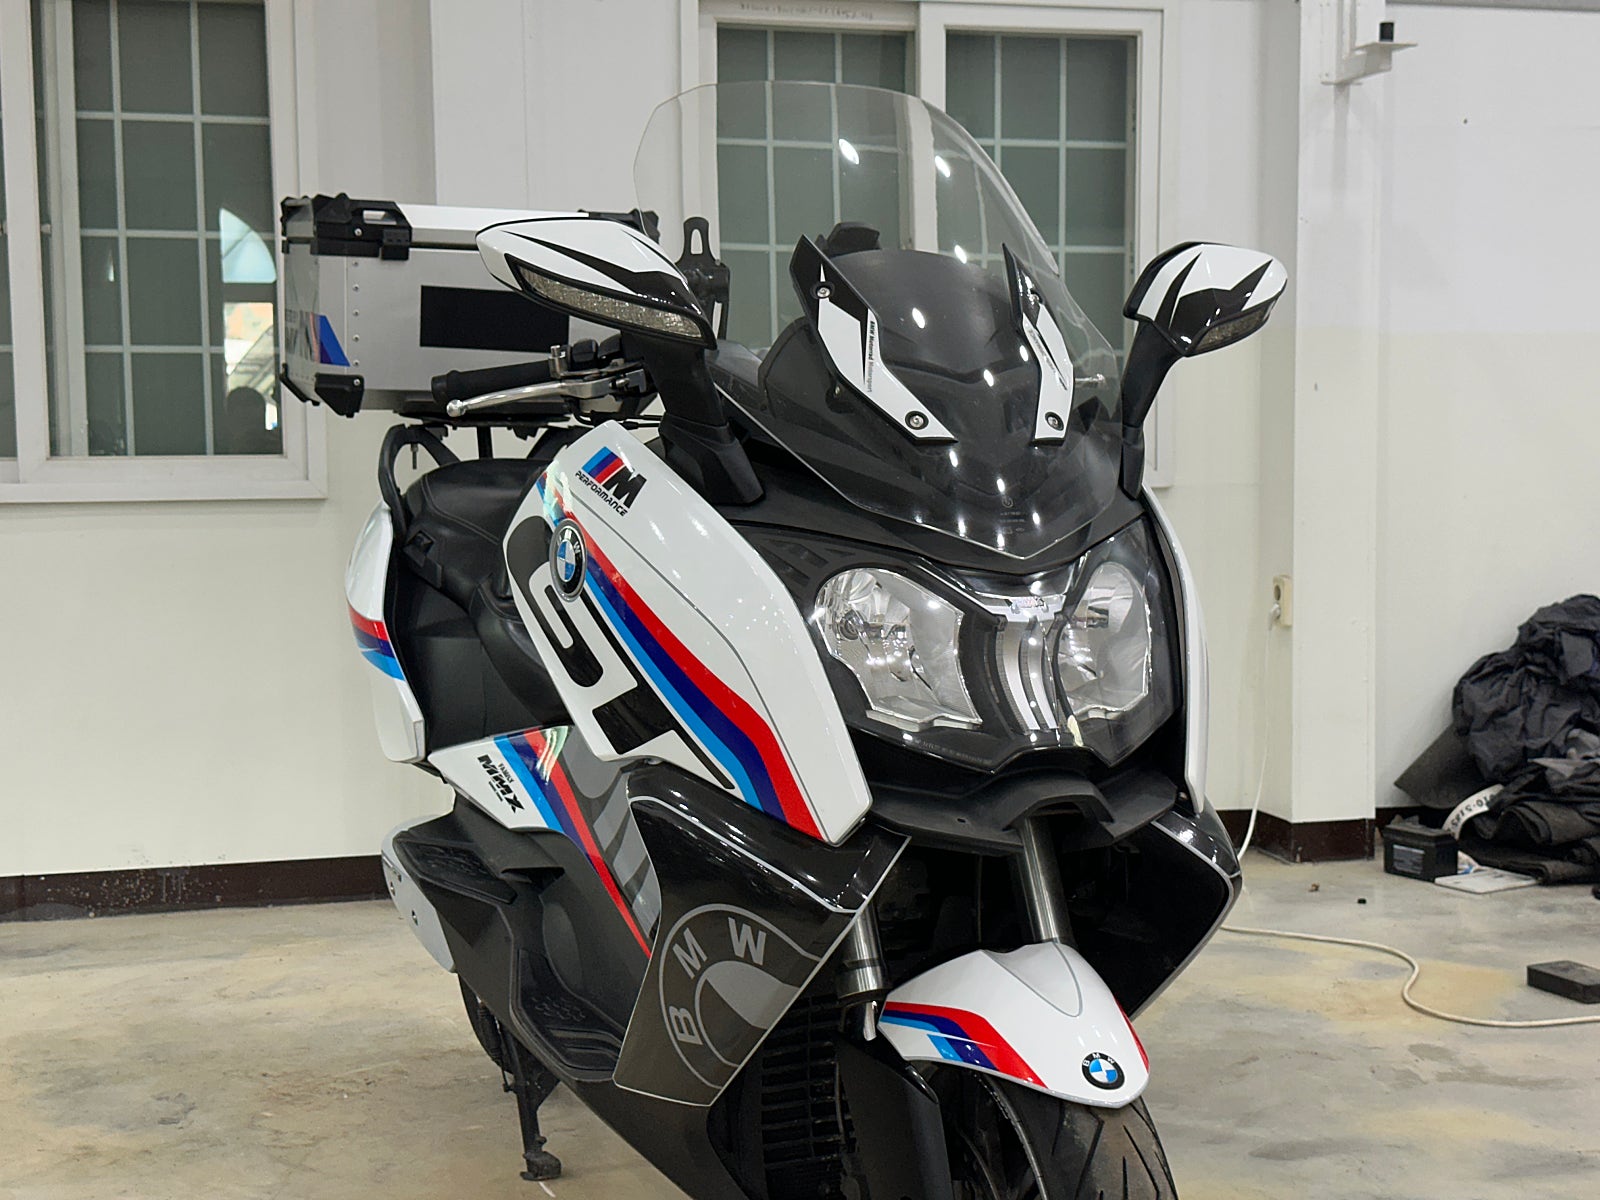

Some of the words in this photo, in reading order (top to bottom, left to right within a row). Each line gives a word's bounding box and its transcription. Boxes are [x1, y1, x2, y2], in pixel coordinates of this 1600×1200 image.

[575, 470, 629, 517] PERFORMANCE
[477, 754, 525, 814] MMX
[668, 917, 767, 1046] BMW
[1082, 1052, 1116, 1067] BMW
